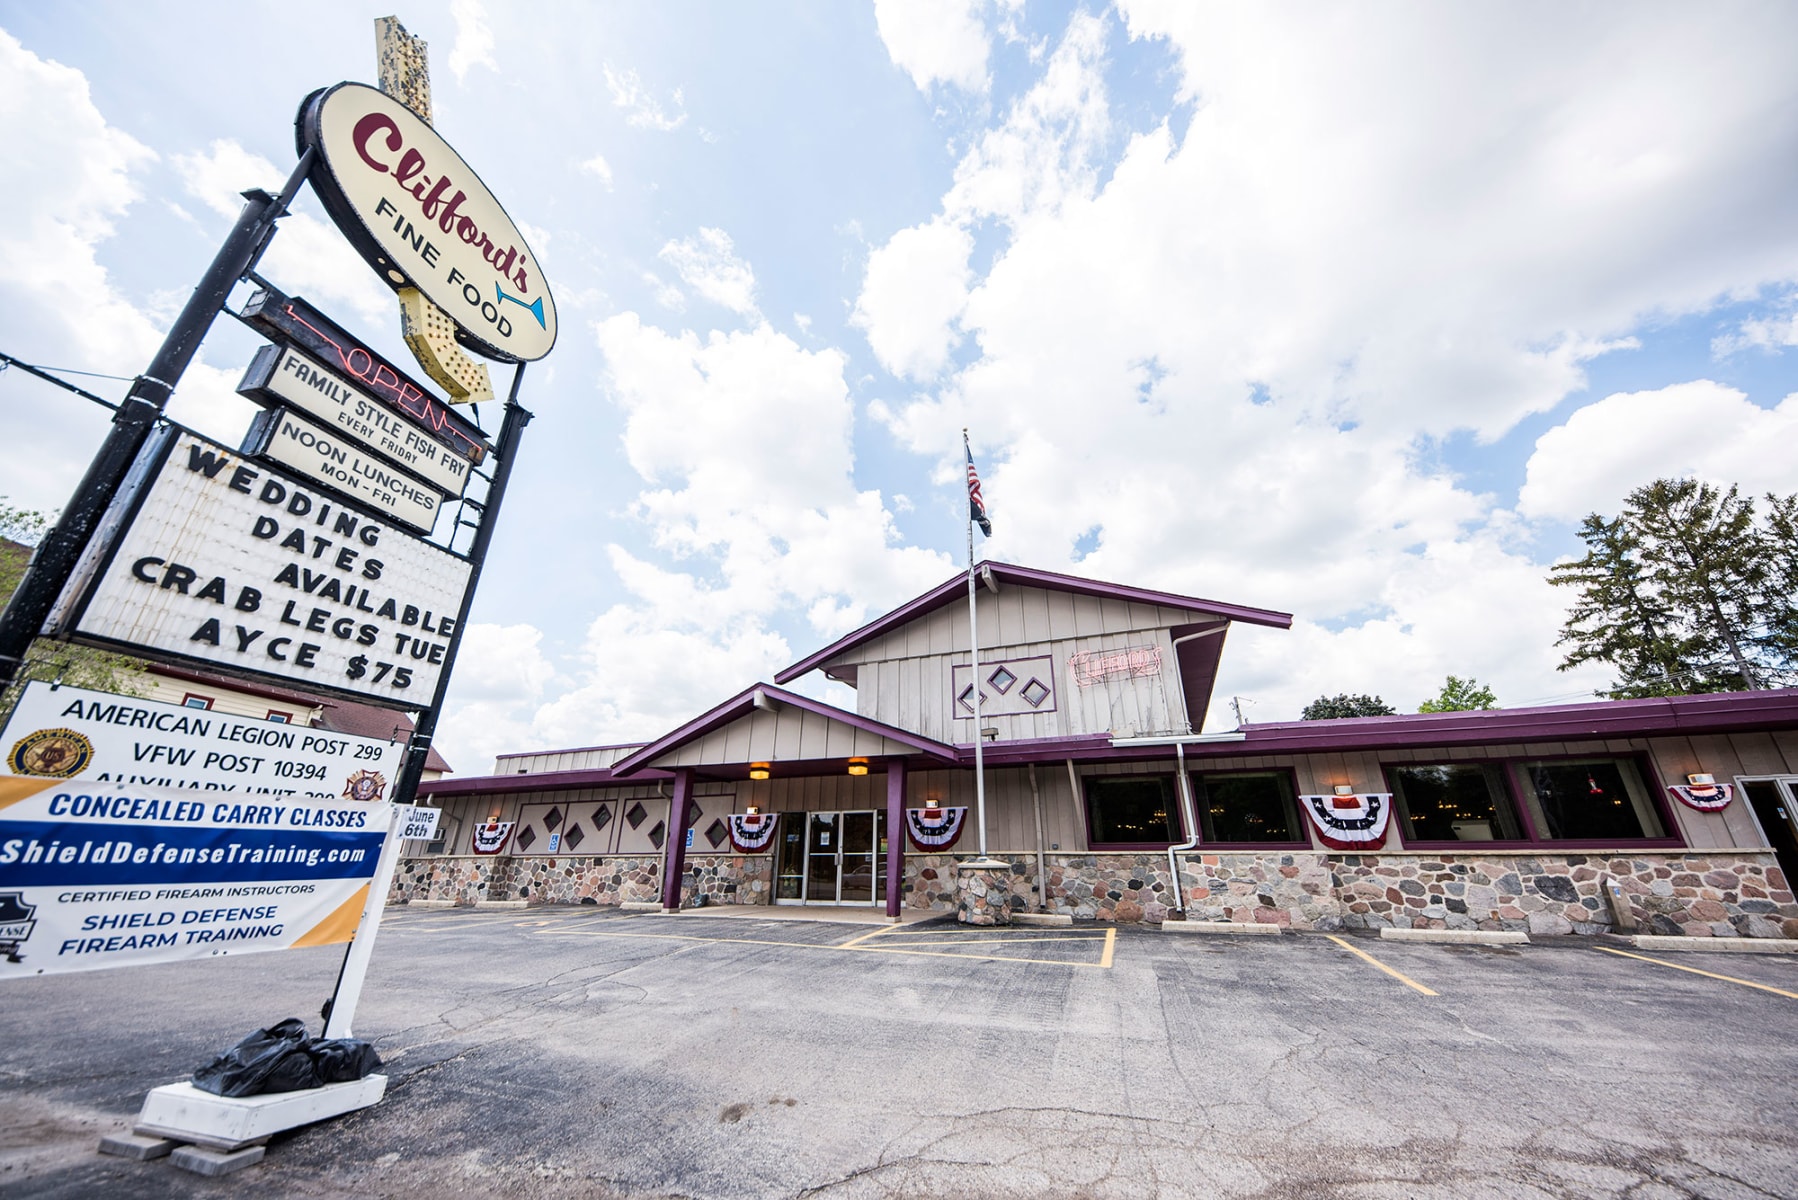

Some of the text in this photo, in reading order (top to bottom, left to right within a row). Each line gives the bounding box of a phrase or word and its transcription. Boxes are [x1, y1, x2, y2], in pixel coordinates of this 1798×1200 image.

[353, 113, 527, 293] Clifford's
[375, 197, 512, 338] FINE FOOD
[283, 356, 465, 477] FAMILY STYLE FISH FRY
[341, 348, 448, 431] OPEN
[281, 421, 434, 510] NOON LUNCHES
[338, 411, 418, 464] EVERY FRIDAY
[187, 445, 381, 547] WEDDING
[252, 515, 384, 580] DATES
[131, 556, 446, 666] CRAB LEGS TUE
[274, 562, 455, 638] AVAILABLE
[190, 618, 413, 689] AYCE $75
[61, 699, 383, 762] AMERICAN LEGION POST 299
[133, 742, 327, 781] VFW POST 10394
[48, 793, 367, 828] CONCEALED CARRY CLASSES
[404, 824, 427, 837] 6th
[408, 809, 434, 823] June
[0, 838, 365, 867] ShieldDefenseTraining.com
[57, 884, 316, 903] CERTIFIED FIREARM INSTRUCTORS
[81, 905, 278, 932] SHIELD DEFENSE
[57, 923, 284, 956] FIREARM TRAINING
